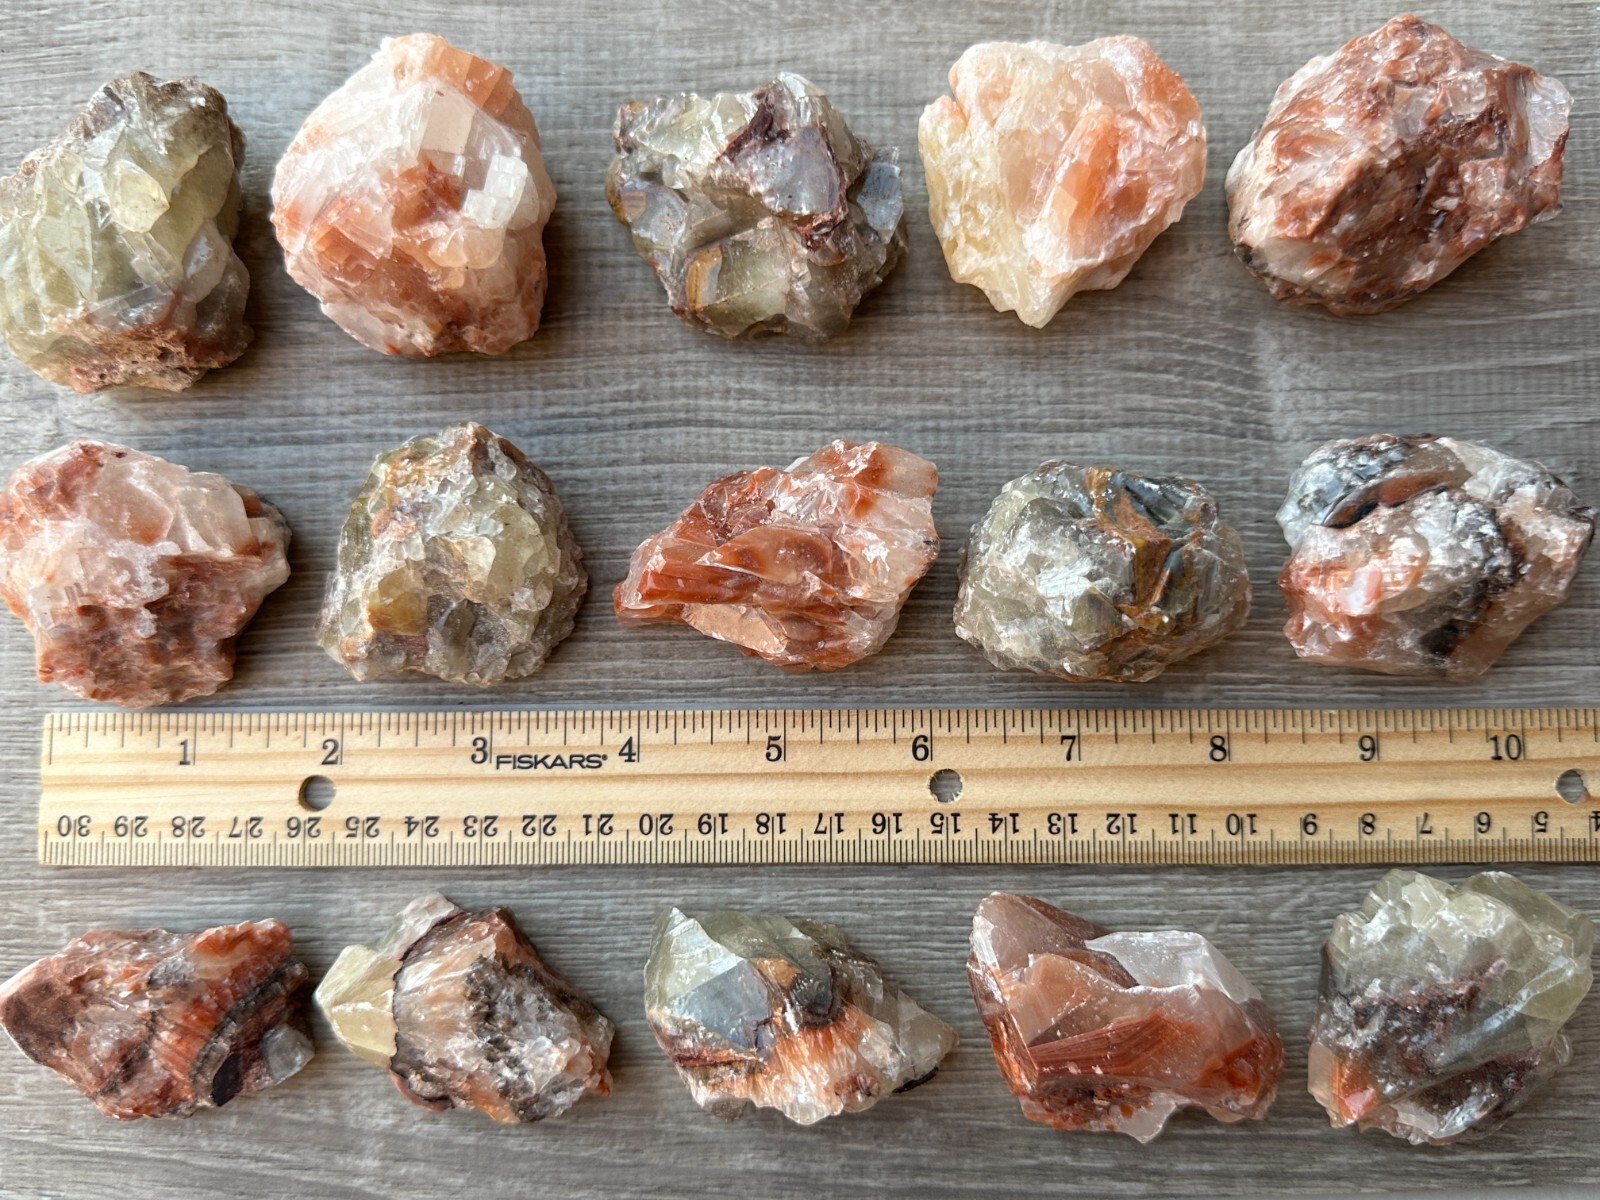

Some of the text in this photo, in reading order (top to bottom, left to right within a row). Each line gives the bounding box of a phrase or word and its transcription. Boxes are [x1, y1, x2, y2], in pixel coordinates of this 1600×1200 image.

[179, 735, 1522, 765] 1 2 3 4 5 6 7 8 9 10
[496, 753, 604, 770] FISKARS
[58, 815, 91, 837] 30
[115, 816, 148, 837] 29
[172, 816, 205, 837] 28
[229, 816, 263, 837] 27
[287, 816, 321, 837] 26
[346, 816, 380, 837] 25
[405, 816, 439, 837] 24
[464, 815, 498, 837] 23
[522, 815, 557, 836] 22
[583, 814, 614, 836] 21
[639, 814, 673, 835] 20
[698, 814, 728, 835] 19
[757, 813, 786, 835] 18
[813, 813, 844, 835] 17
[872, 813, 902, 835] 16
[930, 813, 960, 835] 15
[989, 813, 1019, 835] 14
[1047, 813, 1078, 835] 13
[1106, 813, 1136, 835] 12
[1171, 814, 1197, 835] 11
[1226, 813, 1257, 835] 10
[1303, 813, 1317, 835] 9
[1361, 813, 1376, 834] 8
[1420, 814, 1432, 834] 7
[1477, 812, 1491, 833] 6
[1534, 811, 1548, 832] 5
